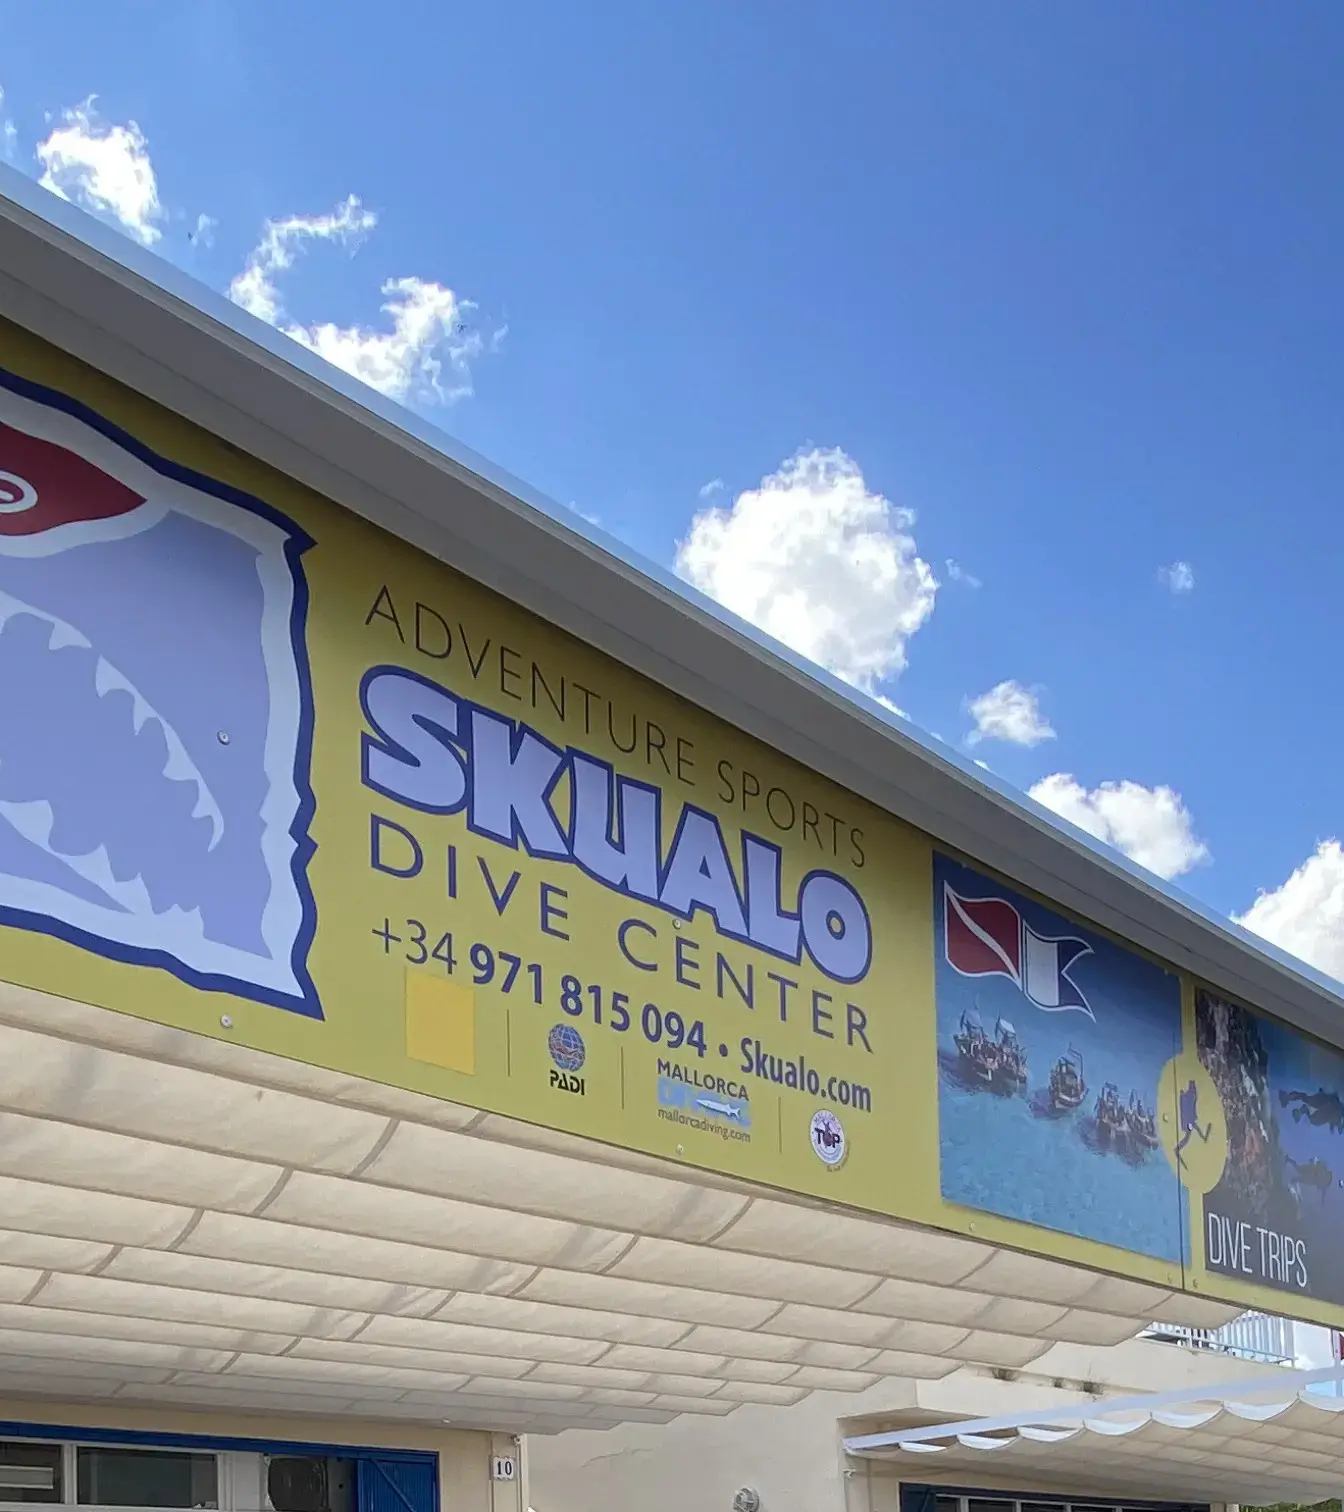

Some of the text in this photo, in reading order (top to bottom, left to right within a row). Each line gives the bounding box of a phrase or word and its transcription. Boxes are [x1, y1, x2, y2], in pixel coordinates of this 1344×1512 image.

[365, 585, 865, 868] ADVENTURE SPORTS
[358, 664, 873, 985] SKUALO
[370, 812, 874, 1054] DIVE CENTER
[371, 917, 458, 976] +34
[469, 942, 543, 1005] 971
[559, 974, 631, 1032] 815
[641, 1002, 708, 1058] 094
[739, 1037, 872, 1113] Skualo.com
[549, 1068, 586, 1096] PADI
[657, 1057, 750, 1101] MALLORCA
[657, 1108, 751, 1143] mallorcadiving.com
[1208, 1211, 1308, 1288] DIVE TRIPS
[497, 1460, 513, 1476] 10
